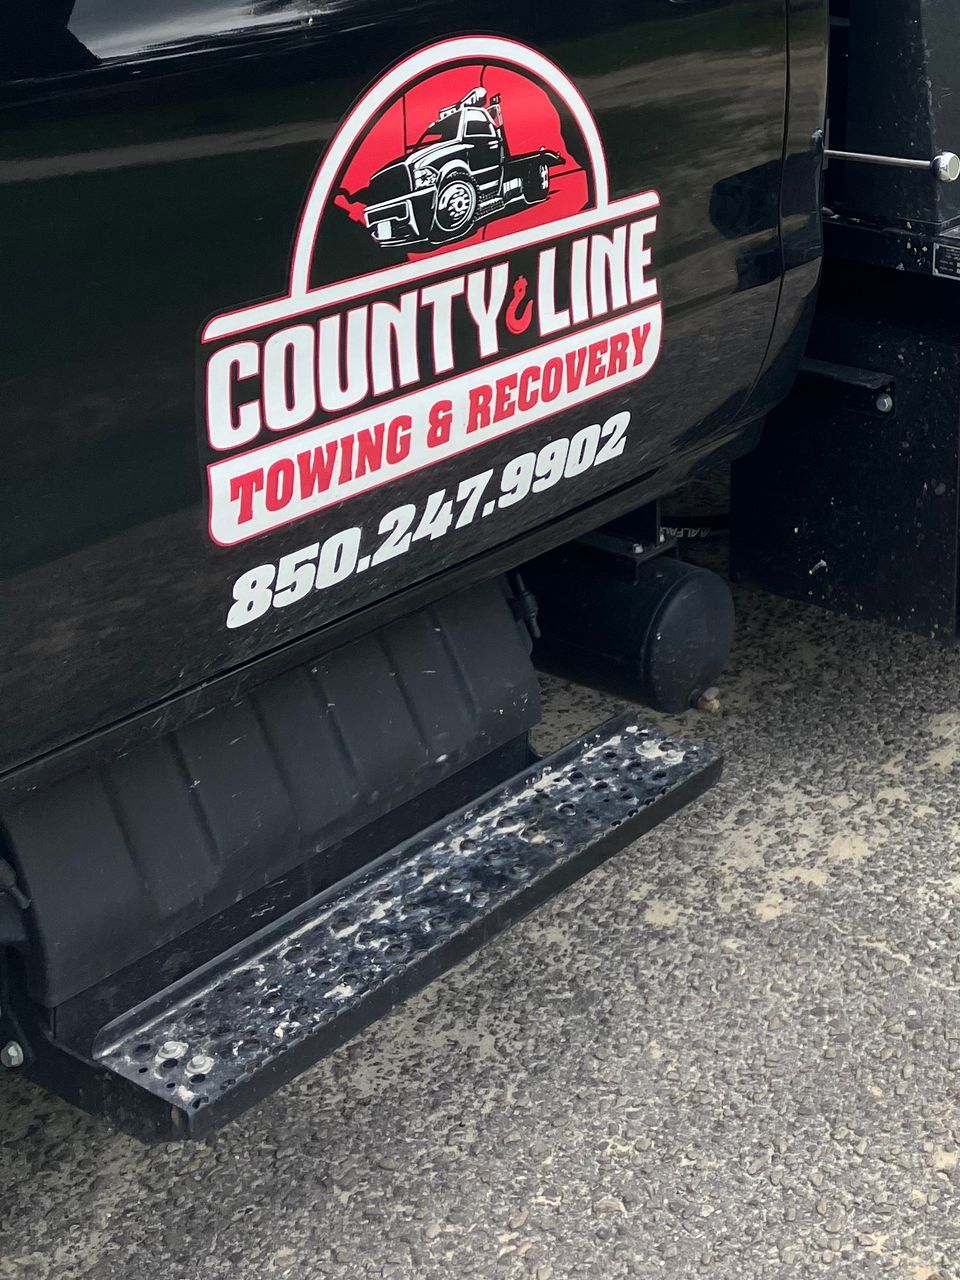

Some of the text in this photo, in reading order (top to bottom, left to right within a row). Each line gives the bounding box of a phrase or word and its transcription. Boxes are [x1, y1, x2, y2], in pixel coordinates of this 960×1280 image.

[206, 214, 658, 452] COUNTY LINE
[229, 322, 651, 525] TOWING & RECOVERY
[226, 410, 632, 628] 850.247.9902
